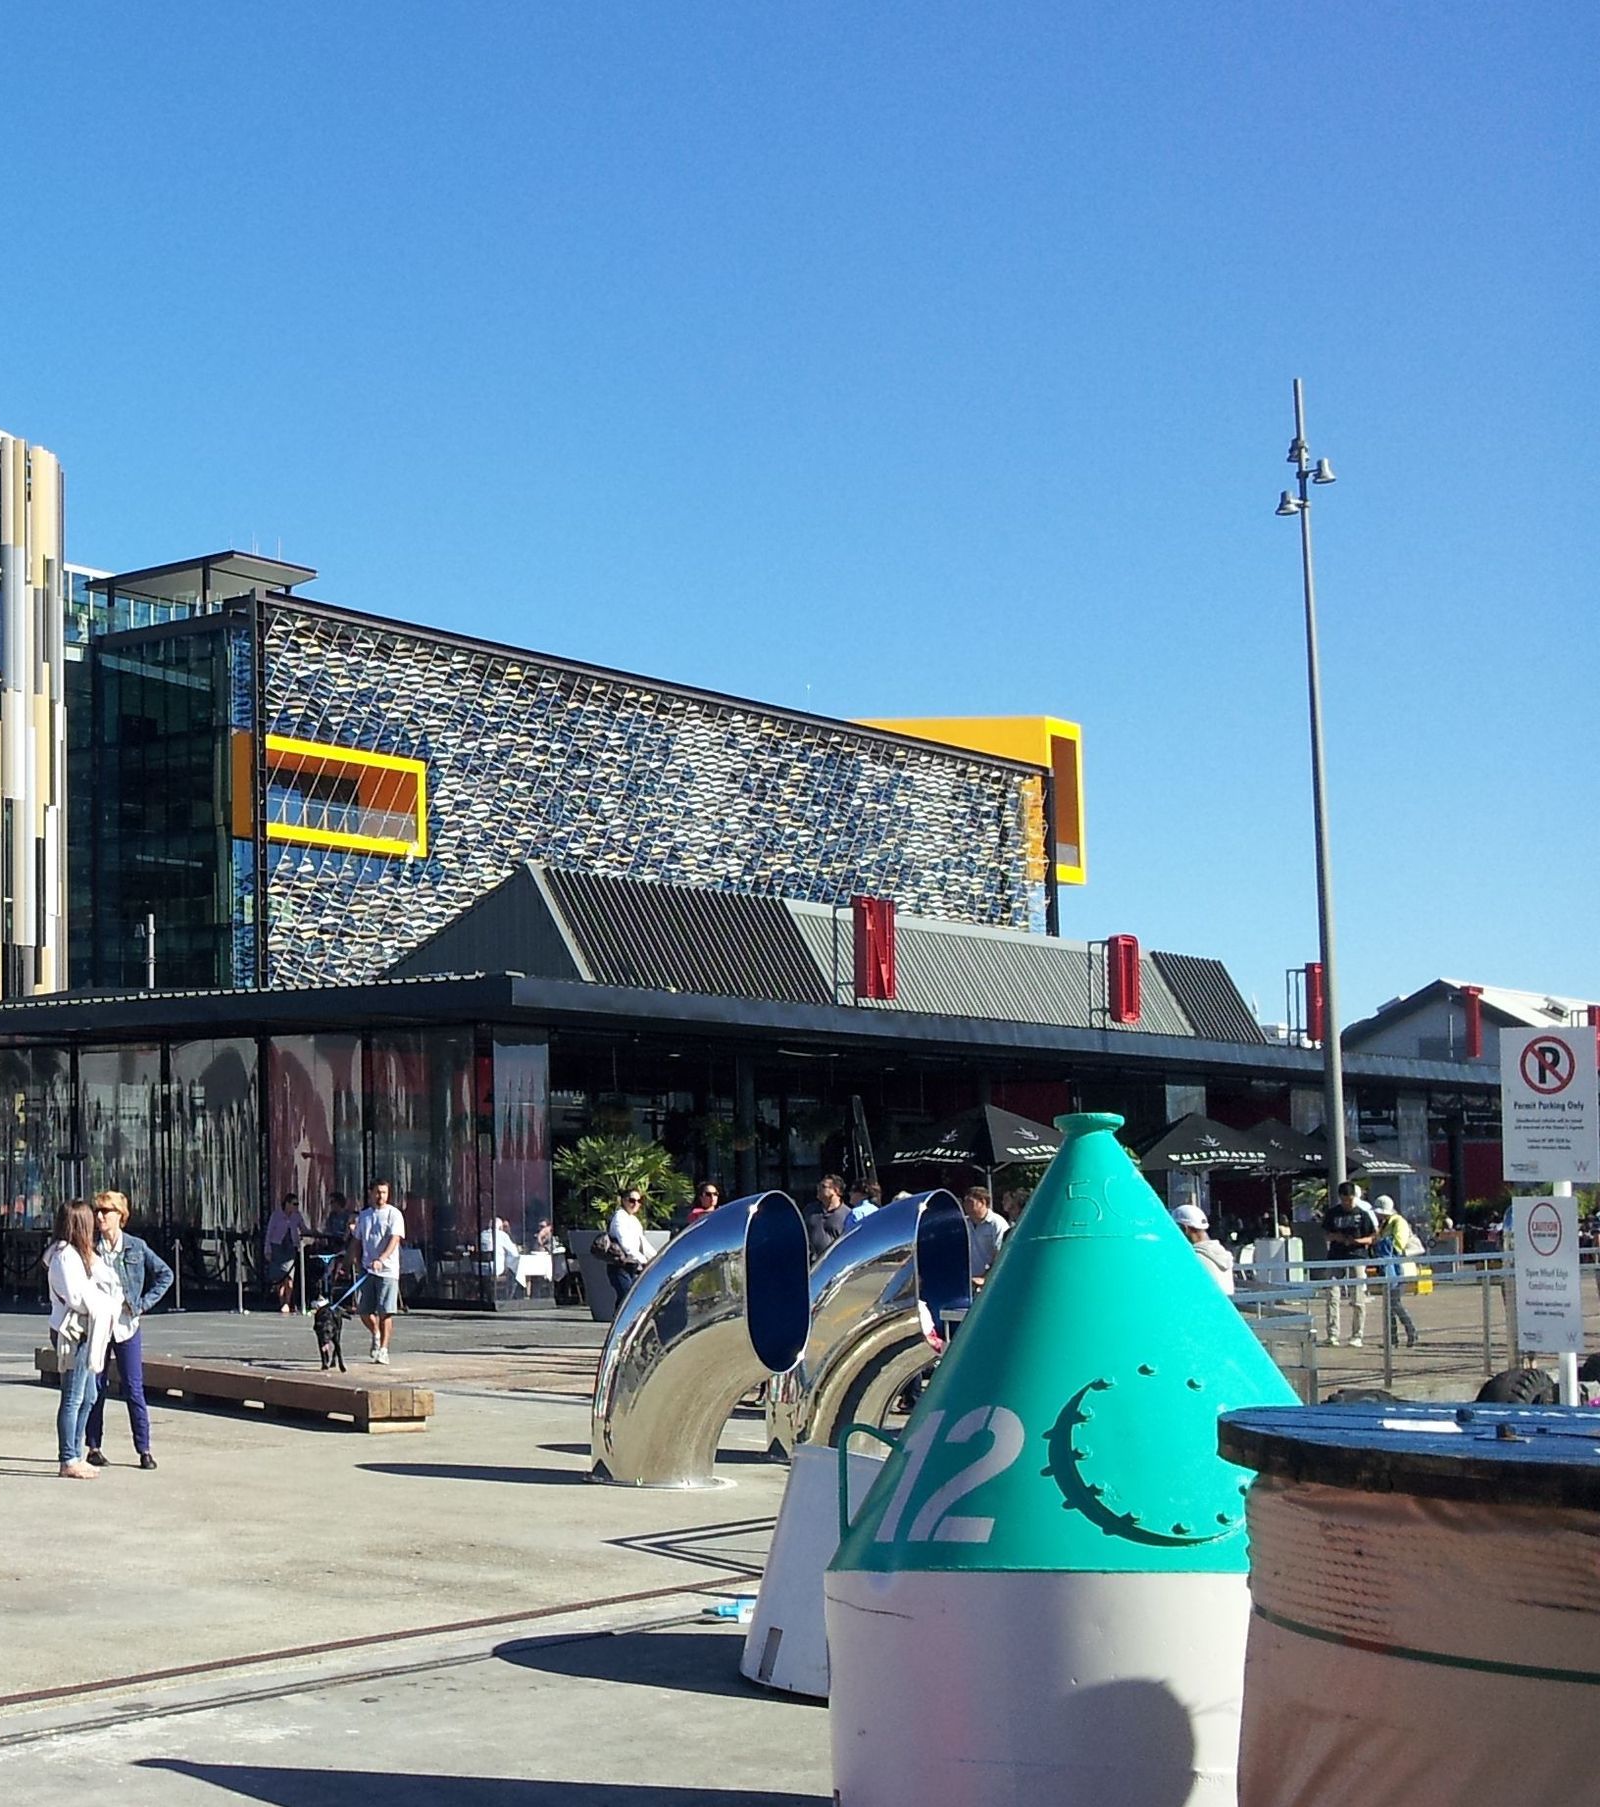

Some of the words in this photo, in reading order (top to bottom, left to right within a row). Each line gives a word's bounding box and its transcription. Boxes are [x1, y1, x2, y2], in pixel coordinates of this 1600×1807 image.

[1513, 1101, 1536, 1110] Permit
[1538, 1101, 1565, 1112] Parking
[1567, 1101, 1584, 1111] Only
[1167, 1150, 1267, 1161] WHITEHAVEN
[874, 1406, 1025, 1543] 12
